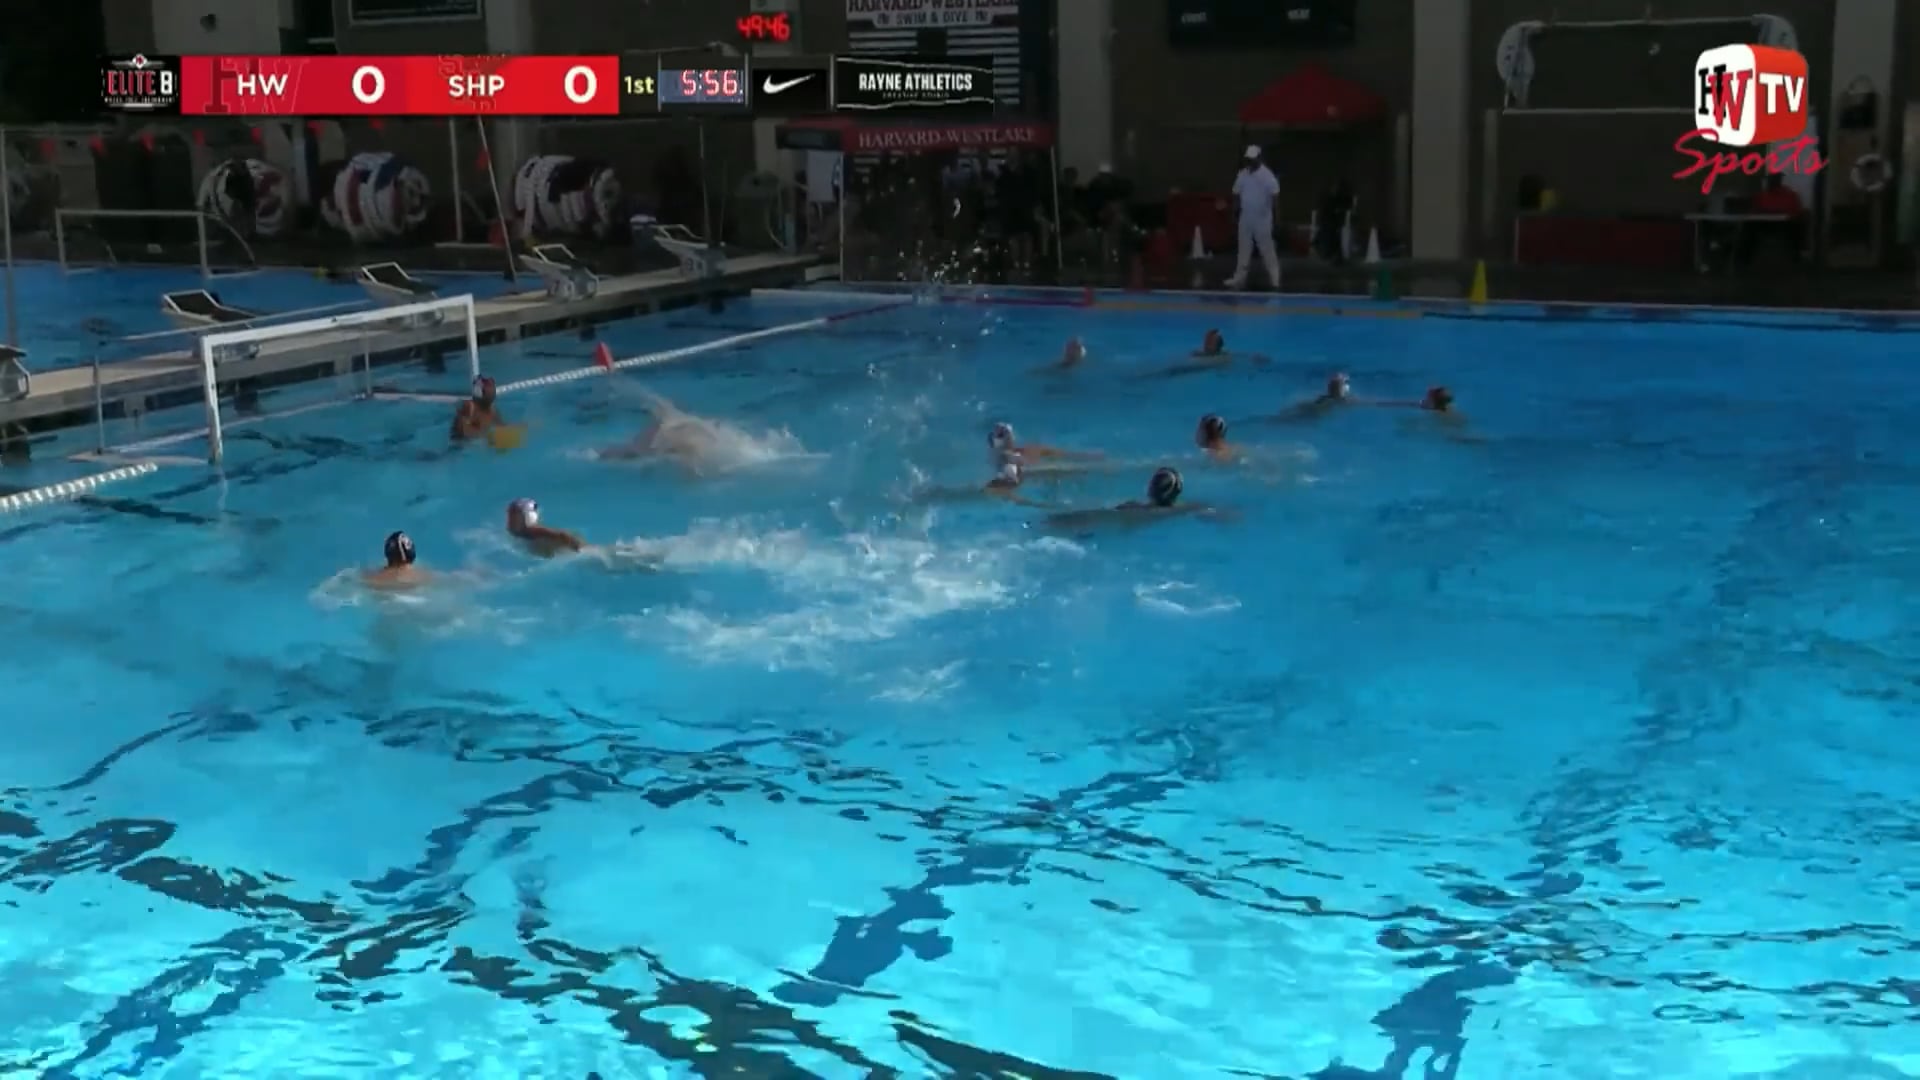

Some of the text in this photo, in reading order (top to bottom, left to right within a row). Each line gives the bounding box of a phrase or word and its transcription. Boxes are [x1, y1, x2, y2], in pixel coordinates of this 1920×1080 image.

[896, 12, 927, 25] SWIM
[943, 11, 968, 24] DIVE
[858, 127, 1036, 148] HARVARD-WESTLAKE
